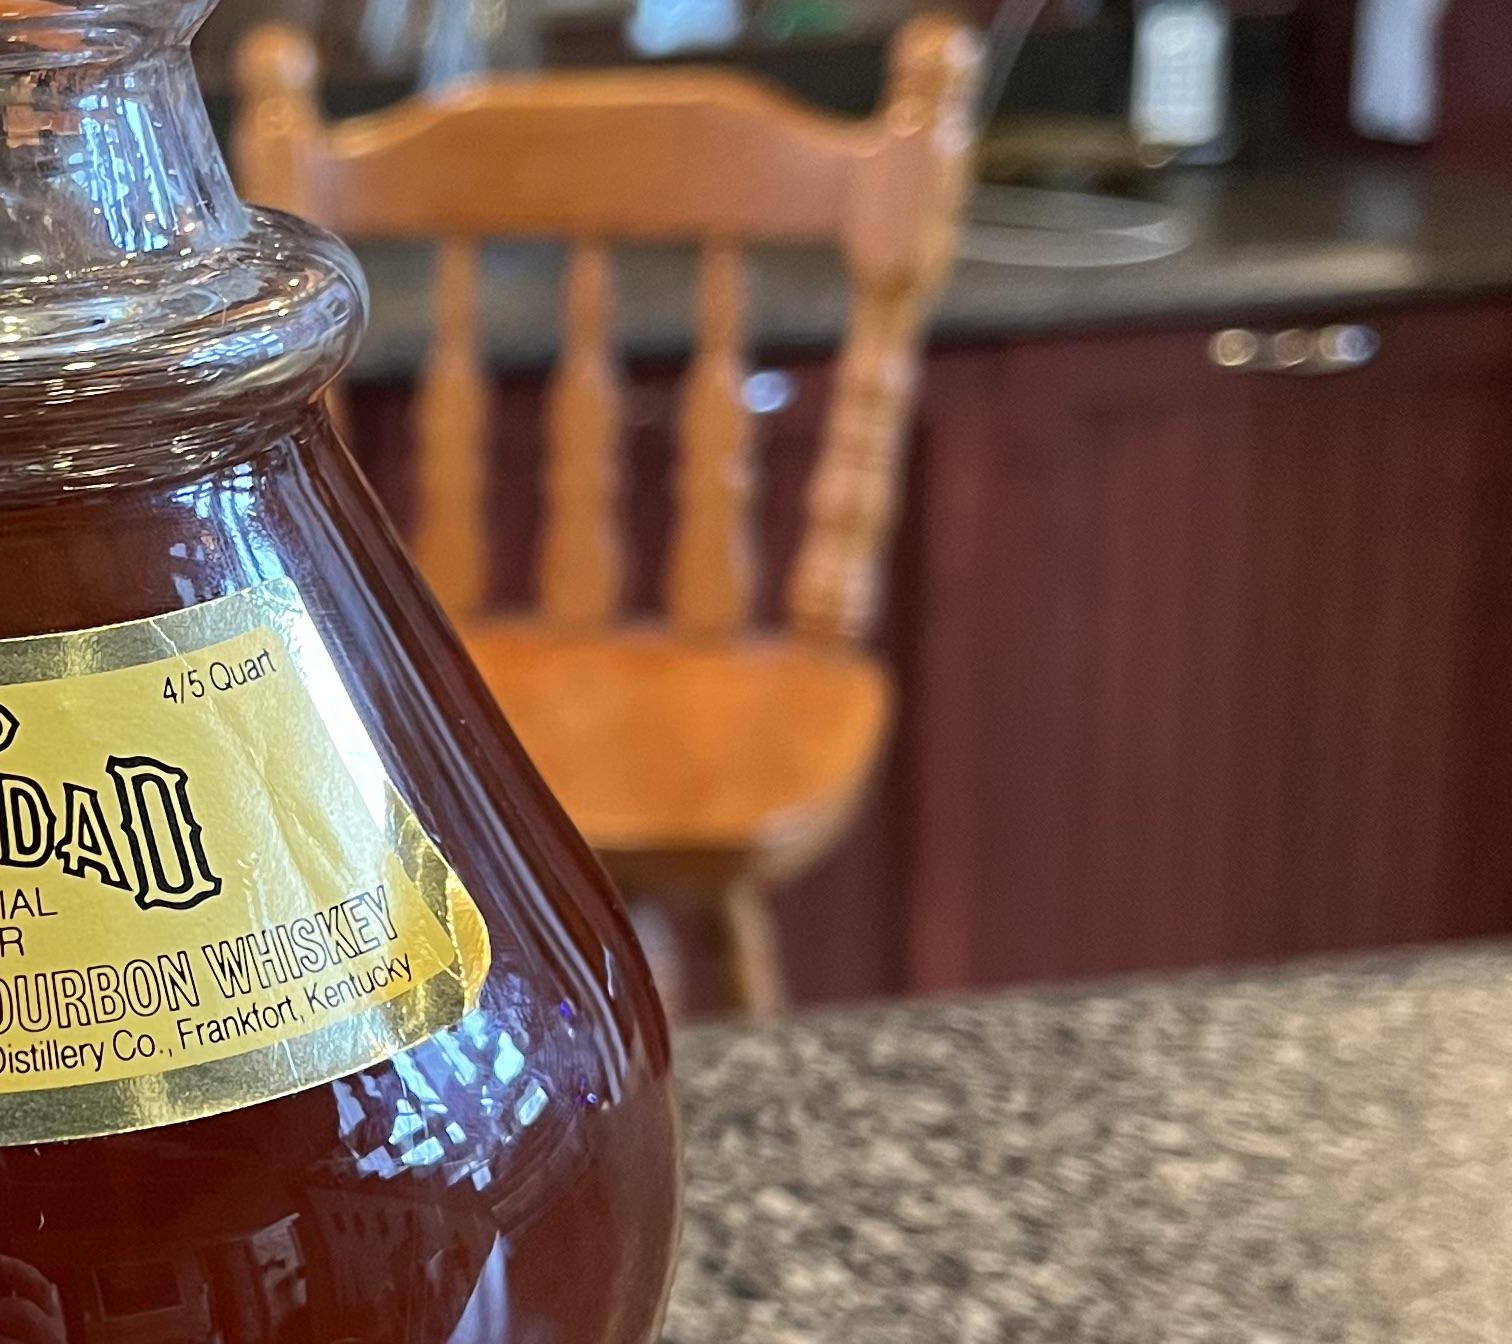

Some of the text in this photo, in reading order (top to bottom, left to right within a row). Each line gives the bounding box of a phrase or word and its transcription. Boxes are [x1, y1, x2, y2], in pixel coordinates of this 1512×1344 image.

[162, 648, 277, 704] 4/5 Quart
[202, 885, 400, 1000] WHISKEY
[177, 999, 305, 1050] Frankfort,
[305, 953, 413, 1010] Kentucky
